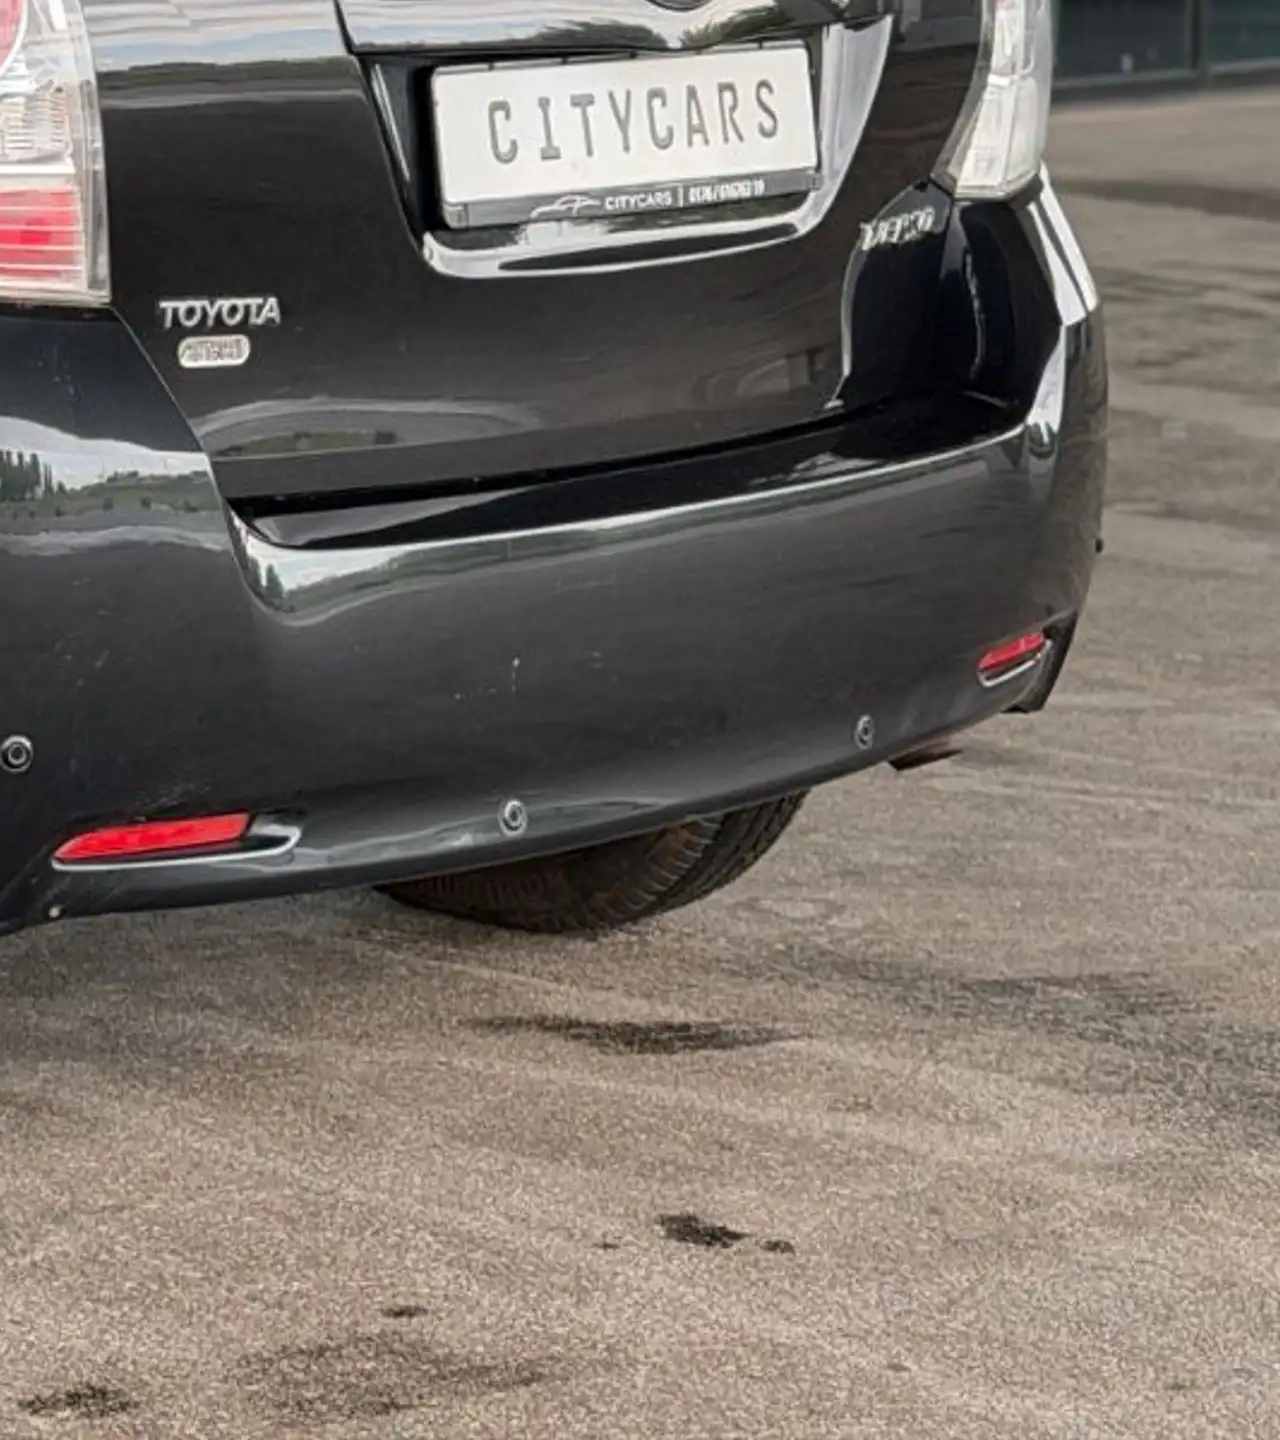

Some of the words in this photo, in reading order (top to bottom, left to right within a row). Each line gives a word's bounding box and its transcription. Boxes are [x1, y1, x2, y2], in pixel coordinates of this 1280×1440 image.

[487, 78, 780, 164] CITYCARS
[604, 191, 673, 210] CITYCARS
[158, 296, 281, 329] TOYOTA
